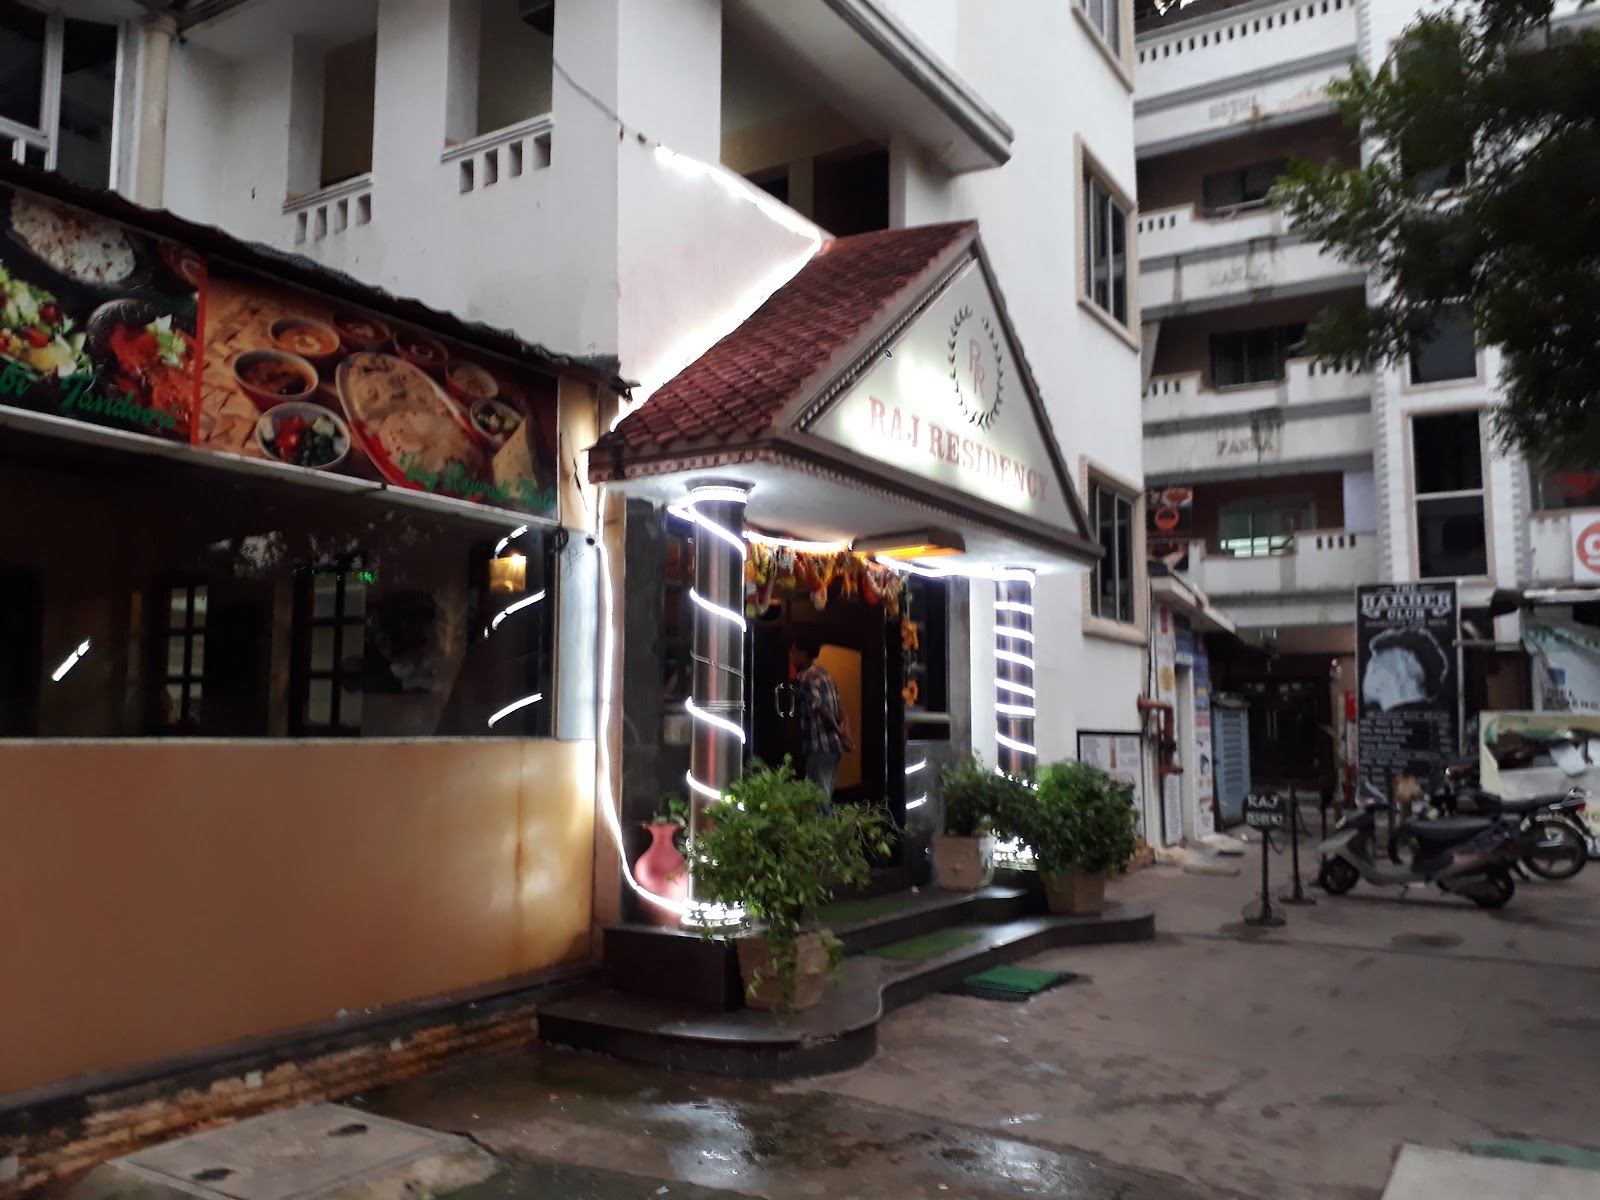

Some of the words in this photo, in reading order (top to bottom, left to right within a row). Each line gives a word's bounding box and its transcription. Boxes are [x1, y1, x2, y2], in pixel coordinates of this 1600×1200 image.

[59, 374, 178, 428] Tandoori
[869, 394, 920, 448] RAJ
[928, 420, 1049, 503] RESIDENCY
[1361, 592, 1452, 617] BARBER
[1387, 607, 1425, 620] CLUB
